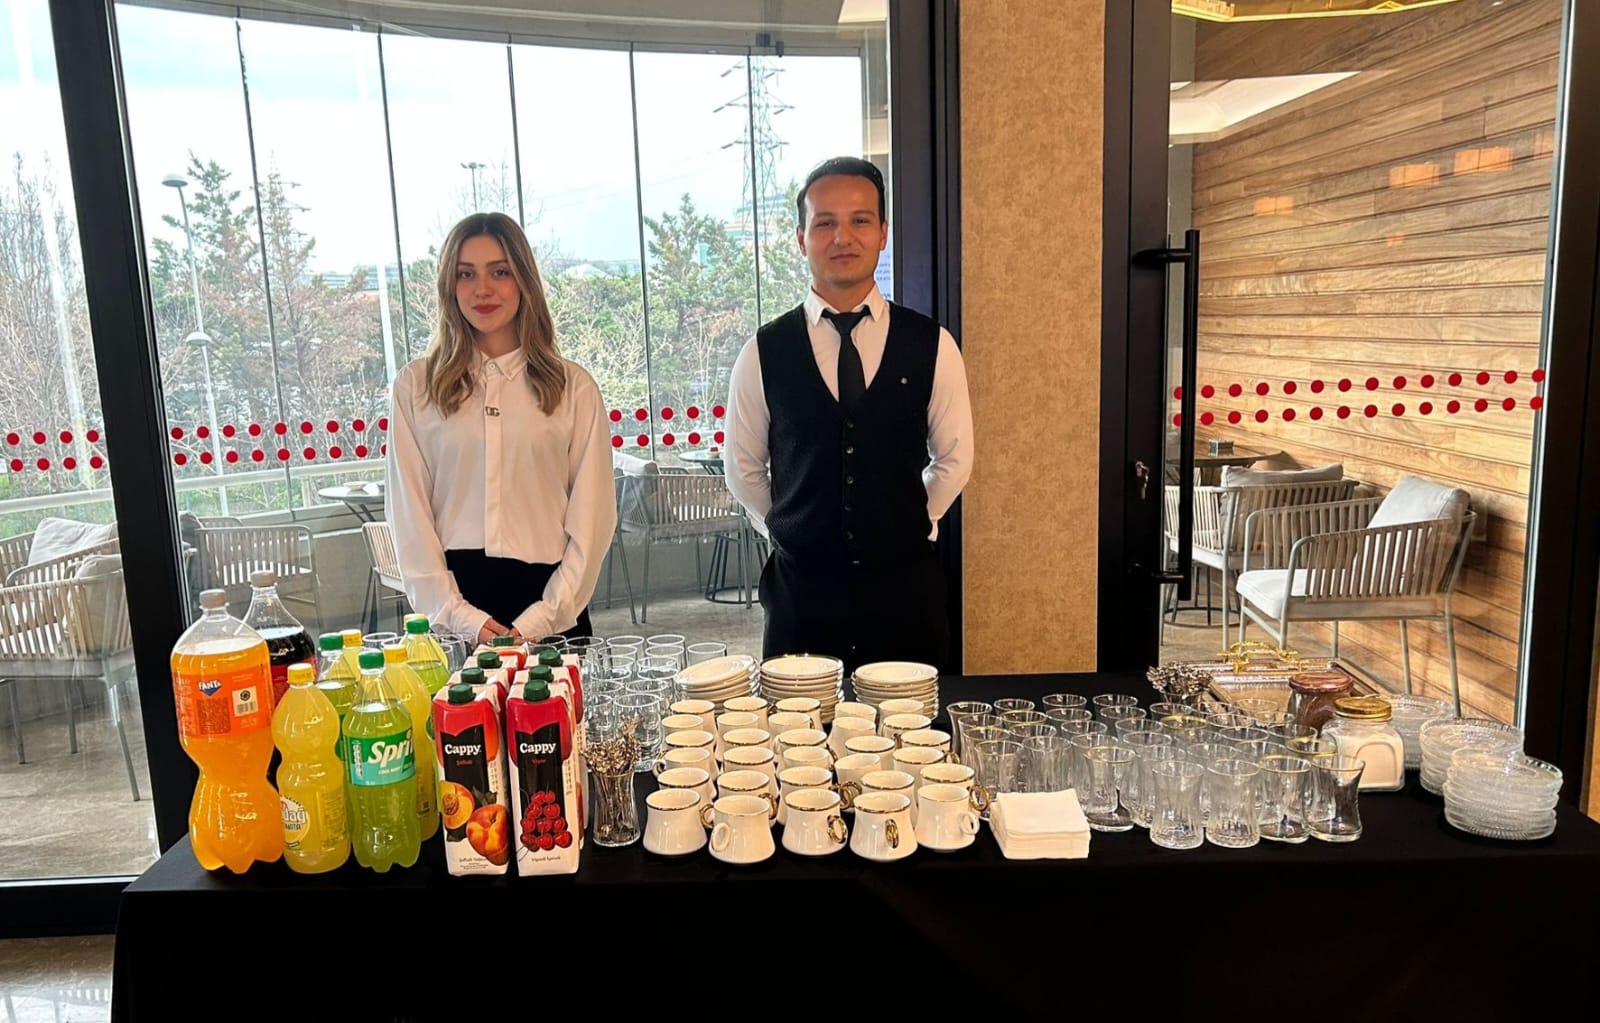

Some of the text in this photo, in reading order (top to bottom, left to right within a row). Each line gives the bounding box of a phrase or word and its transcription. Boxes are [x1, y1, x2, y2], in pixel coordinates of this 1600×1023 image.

[367, 735, 413, 768] Spri
[444, 744, 480, 756] Cappy
[519, 742, 556, 755] Cappy
